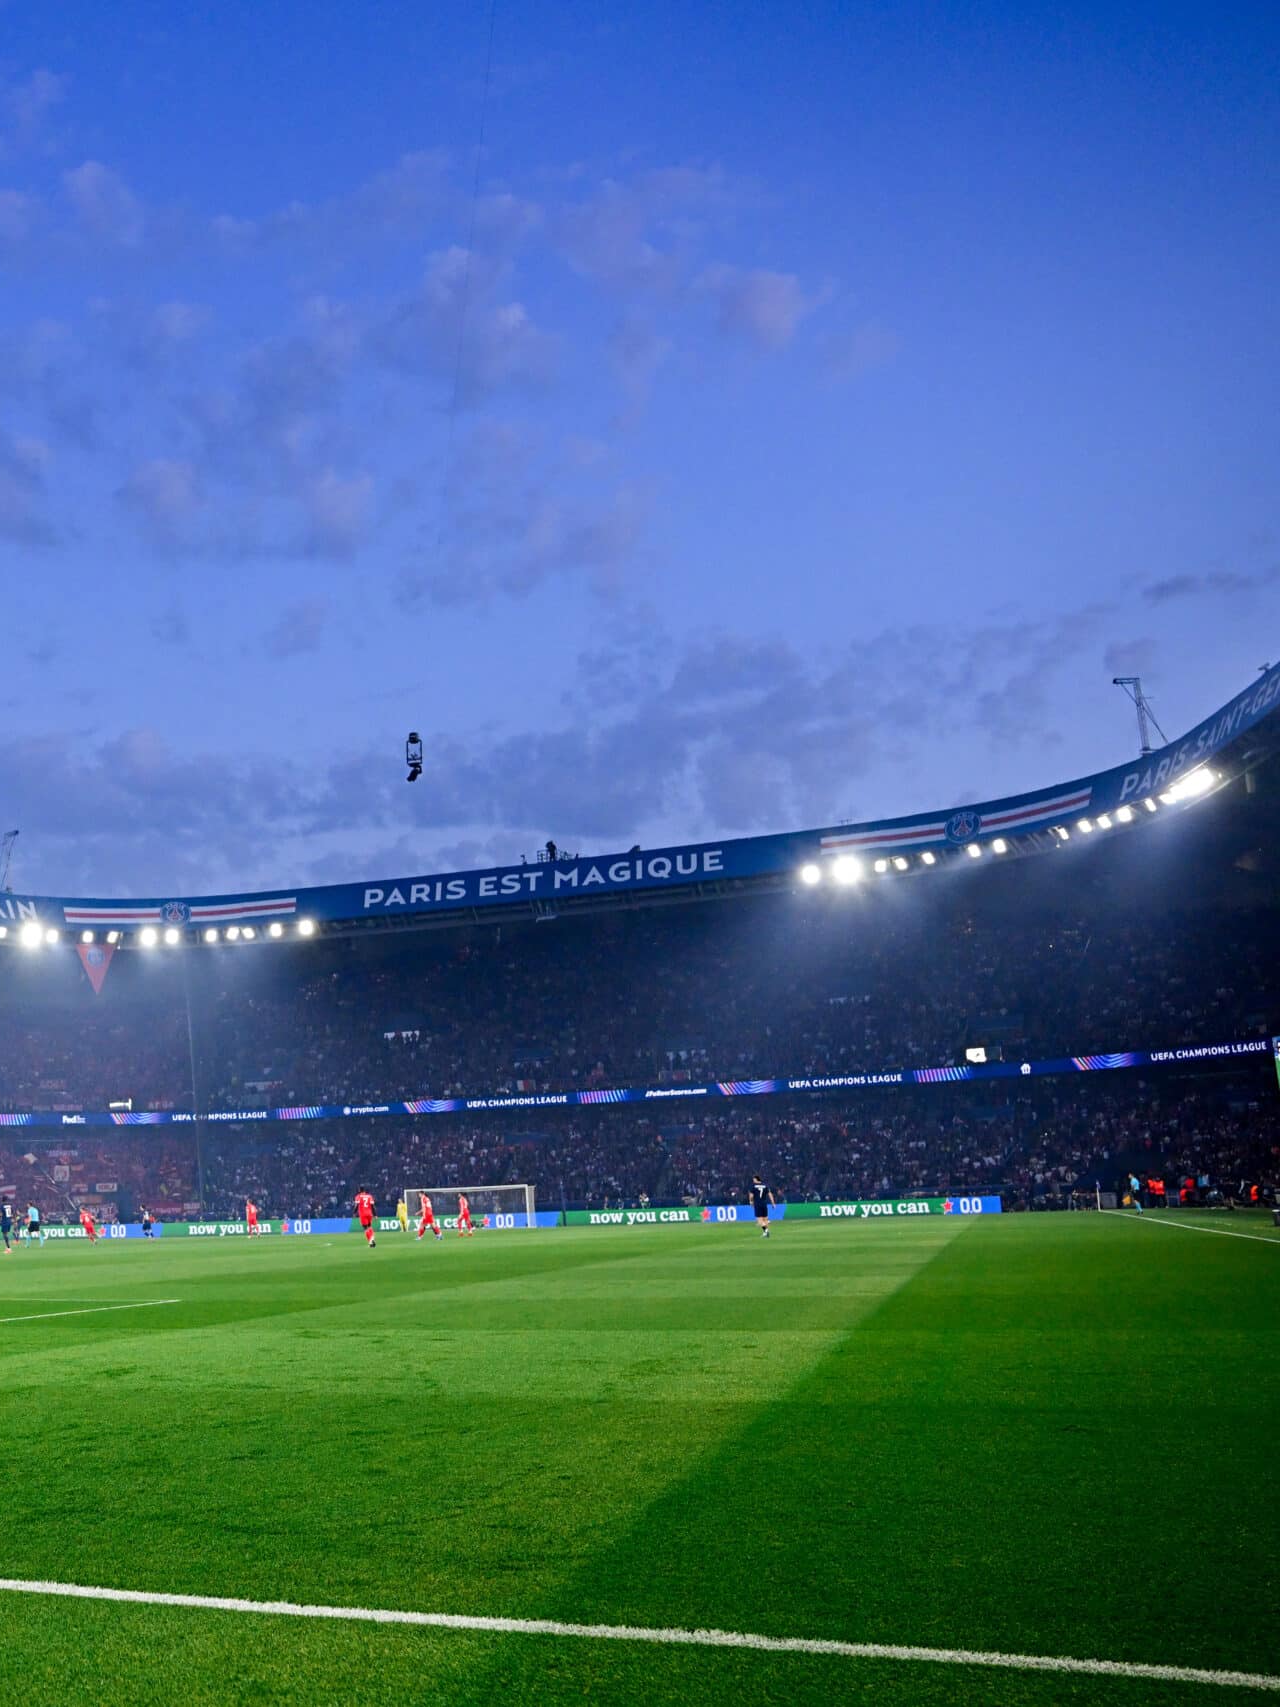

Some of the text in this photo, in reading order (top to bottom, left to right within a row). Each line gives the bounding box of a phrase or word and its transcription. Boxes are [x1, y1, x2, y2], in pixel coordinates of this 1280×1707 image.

[1120, 742, 1190, 801] PARIS
[363, 850, 725, 909] PARIS EST MAGIQUE
[1150, 1041, 1267, 1062] UEFA CHAMPIONS LEAGUE
[788, 1073, 902, 1089] UEFA CHAMPIONS LEAGUE
[466, 1095, 568, 1108] UEFA CHAMPIONS LEAGUE
[238, 1111, 267, 1119] LEAGUE
[351, 1105, 389, 1114] crypto.com
[820, 1202, 930, 1218] now you can
[960, 1197, 982, 1214] 0.0
[496, 1214, 514, 1228] 0.0
[590, 1210, 689, 1225] now you can
[717, 1206, 737, 1222] 0.0
[42, 1227, 65, 1240] you
[111, 1224, 126, 1238] 0.0
[189, 1224, 217, 1235] now
[219, 1223, 244, 1236] you
[294, 1219, 311, 1234] 0.0
